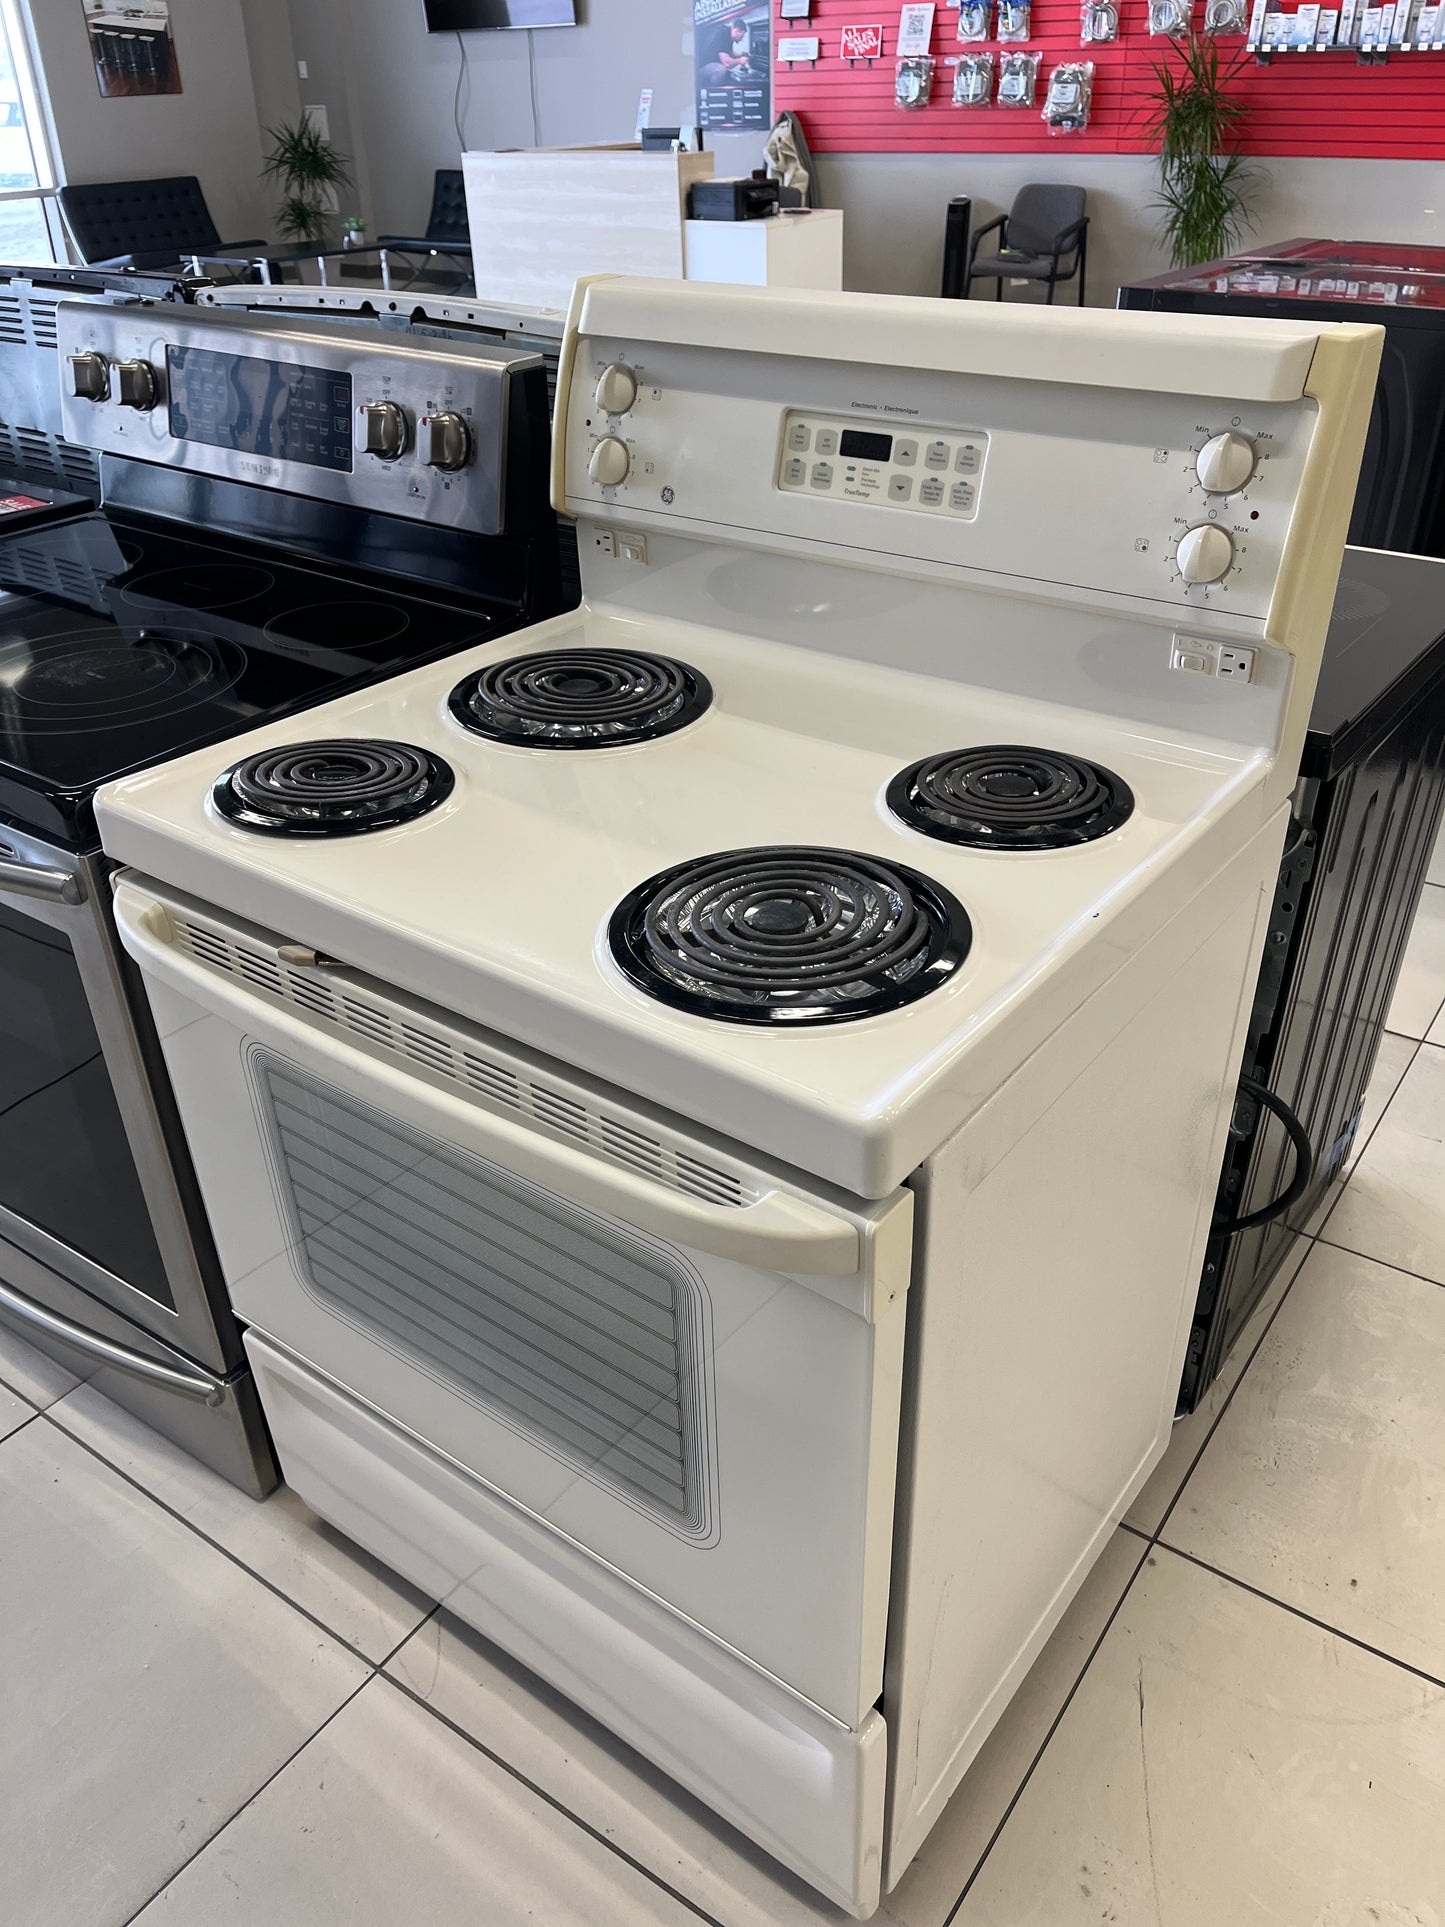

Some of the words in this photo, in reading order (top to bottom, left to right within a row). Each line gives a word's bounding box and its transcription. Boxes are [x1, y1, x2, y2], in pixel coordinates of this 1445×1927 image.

[694, 0, 747, 21] INSTALLATI
[847, 28, 875, 50] SALES
[854, 36, 878, 56] FINAL
[851, 401, 878, 410] Electronic
[884, 405, 919, 415] Electronique
[1256, 432, 1273, 440] Max
[1233, 525, 1249, 533] Max
